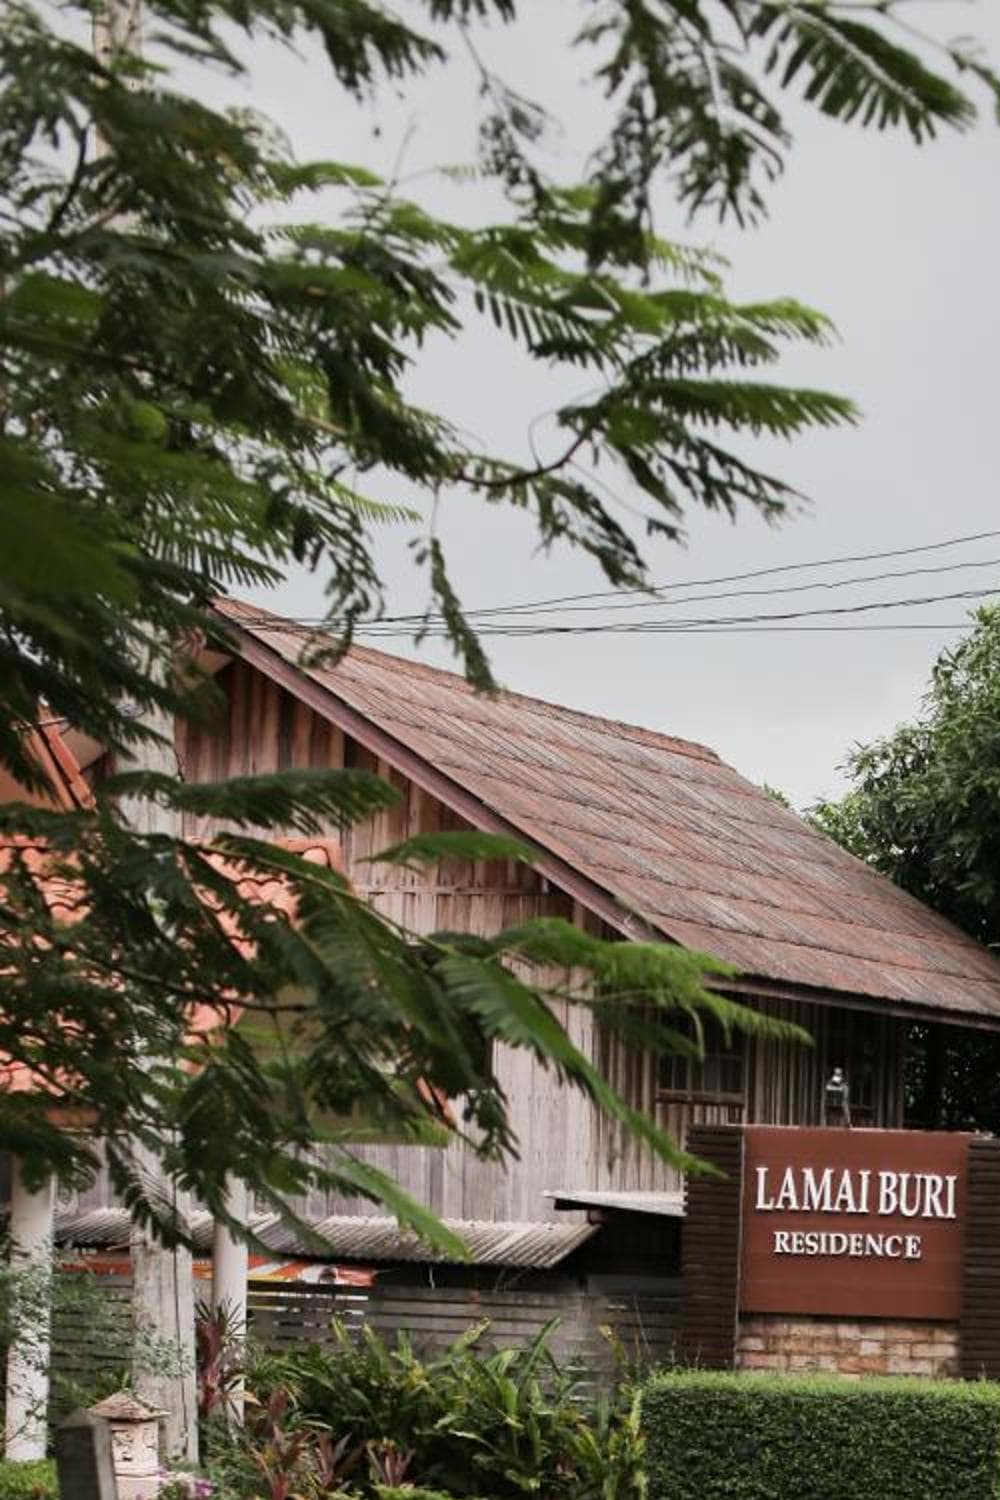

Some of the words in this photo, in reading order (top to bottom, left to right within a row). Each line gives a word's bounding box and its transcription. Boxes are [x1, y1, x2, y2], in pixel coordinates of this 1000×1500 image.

[755, 1167, 870, 1213] LAMAI
[877, 1170, 957, 1219] BURI
[773, 1231, 922, 1259] RESIDENCE
